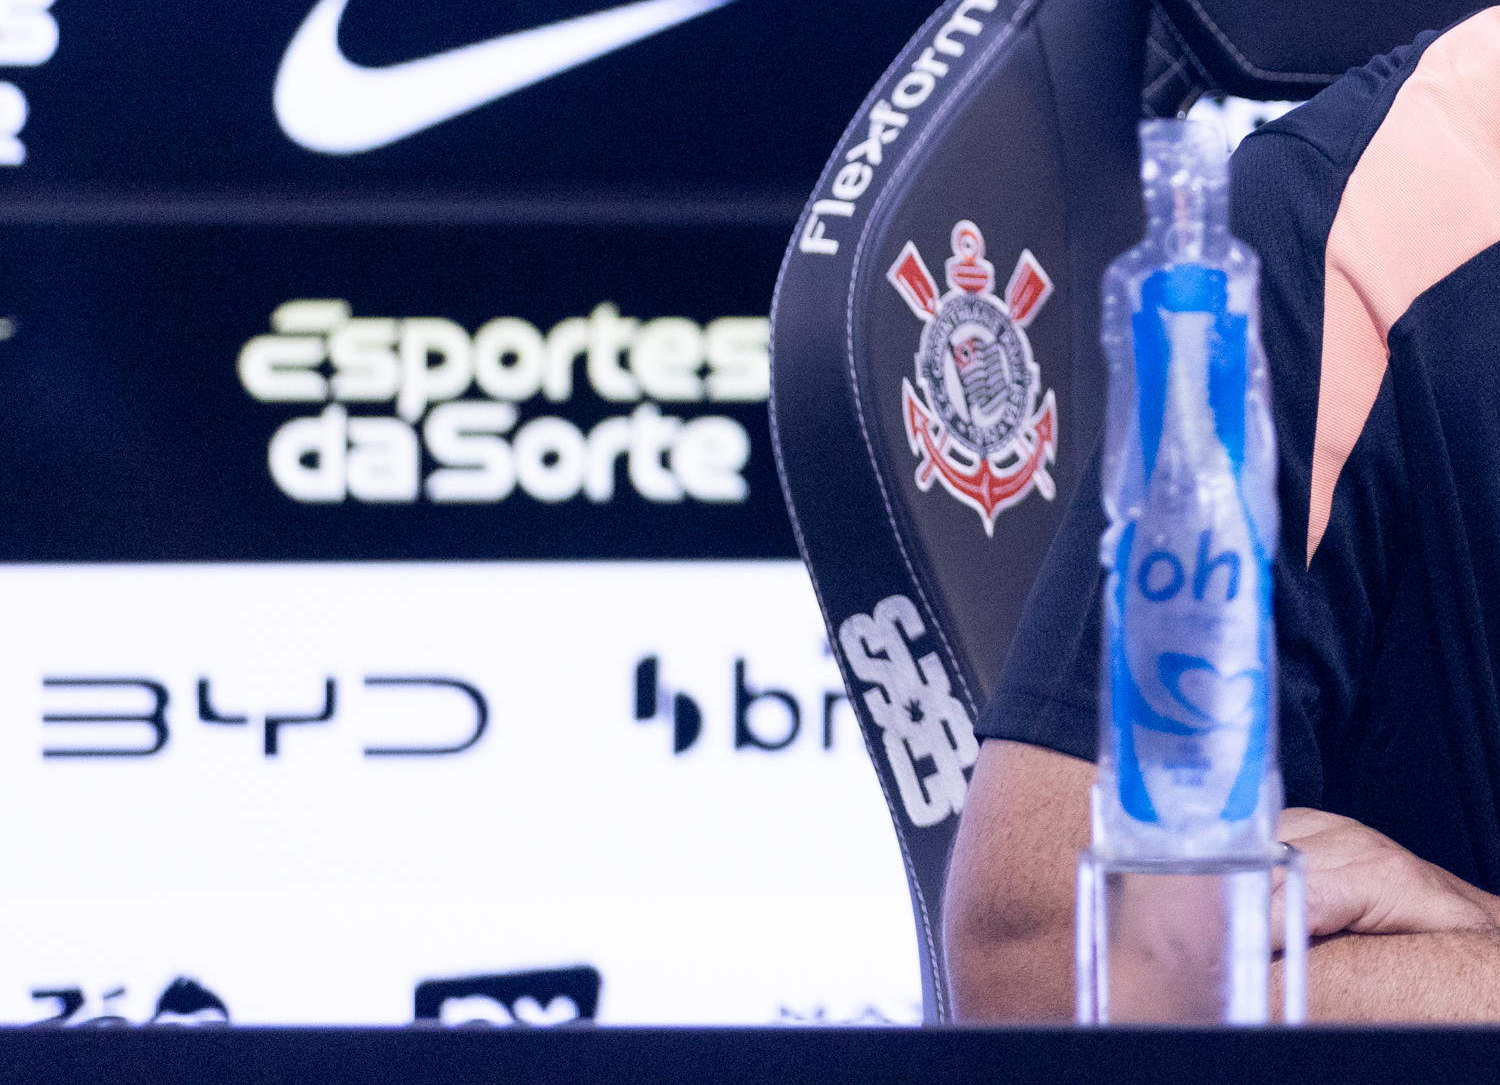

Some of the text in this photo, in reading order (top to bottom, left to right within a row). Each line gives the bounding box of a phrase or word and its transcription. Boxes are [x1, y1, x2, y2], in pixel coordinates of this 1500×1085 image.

[238, 300, 770, 421] Esportes
[1138, 528, 1241, 602] oh
[42, 676, 490, 758] BYD
